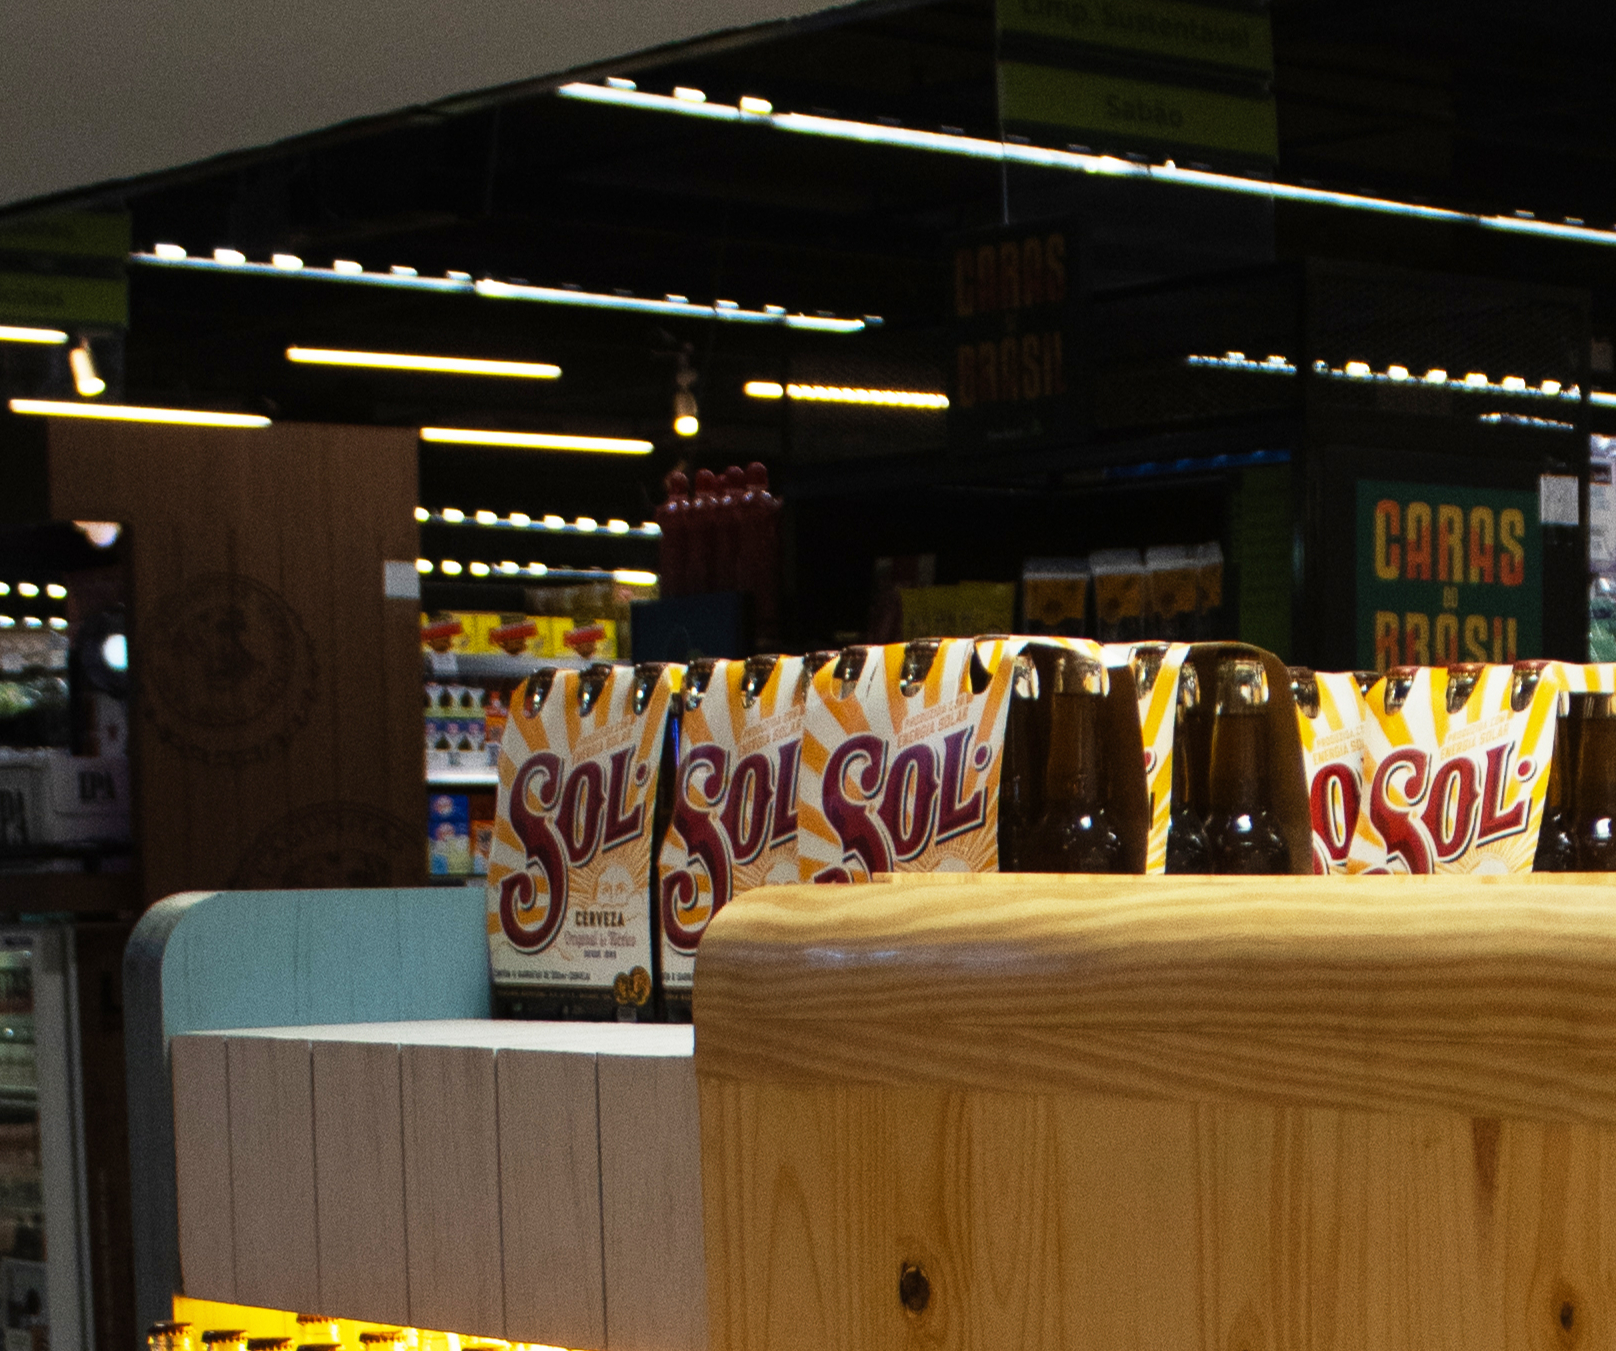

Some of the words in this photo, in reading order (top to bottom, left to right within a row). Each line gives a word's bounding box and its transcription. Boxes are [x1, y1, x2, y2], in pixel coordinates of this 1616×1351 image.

[954, 232, 1067, 317] CARAS
[1374, 498, 1526, 587] CARAS
[500, 745, 647, 953] SOL
[815, 725, 993, 882] SOL
[1363, 741, 1537, 874] SOL
[575, 911, 626, 928] CERVEZA
